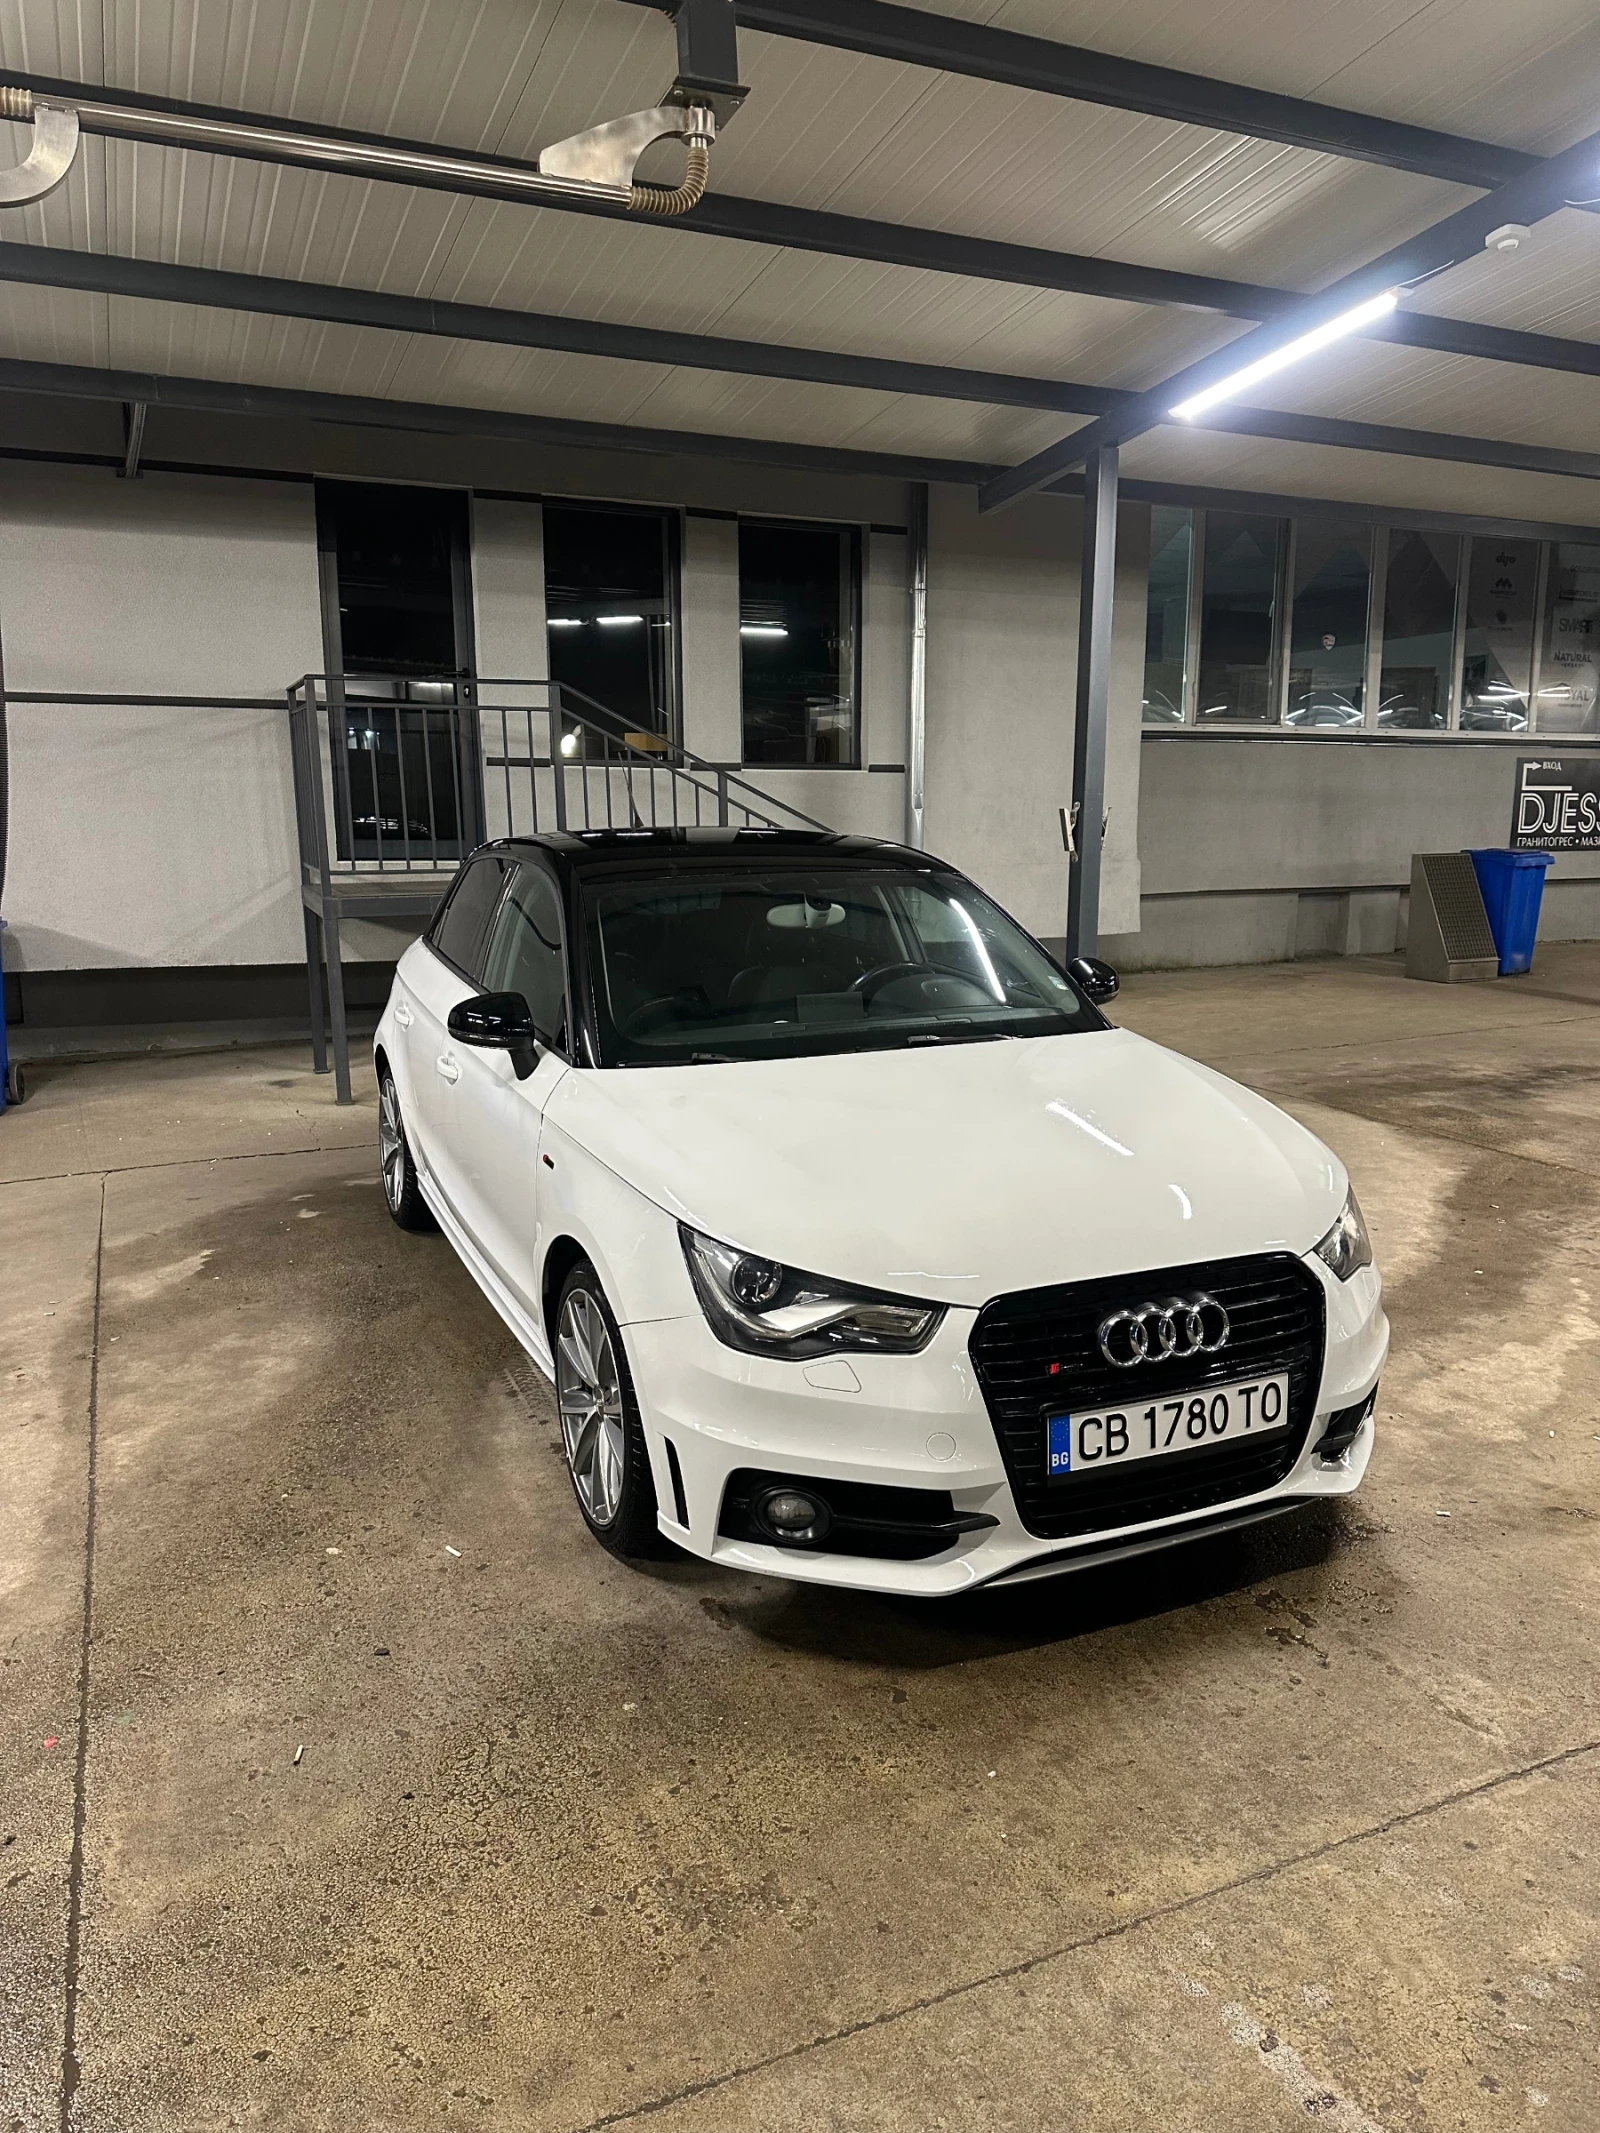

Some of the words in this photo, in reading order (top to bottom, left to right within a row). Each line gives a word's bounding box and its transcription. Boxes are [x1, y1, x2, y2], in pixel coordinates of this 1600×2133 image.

[1554, 650, 1592, 663] NATURAL
[1542, 761, 1562, 771] ВХОД
[1518, 792, 1600, 834] DJES
[1517, 836, 1574, 847] ГРАНИТОГРЕС
[1580, 836, 1600, 846] МАЗ
[1077, 1411, 1130, 1461] CB
[1143, 1393, 1229, 1450] 1780
[1237, 1381, 1283, 1429] TO
[1051, 1451, 1070, 1467] BG
